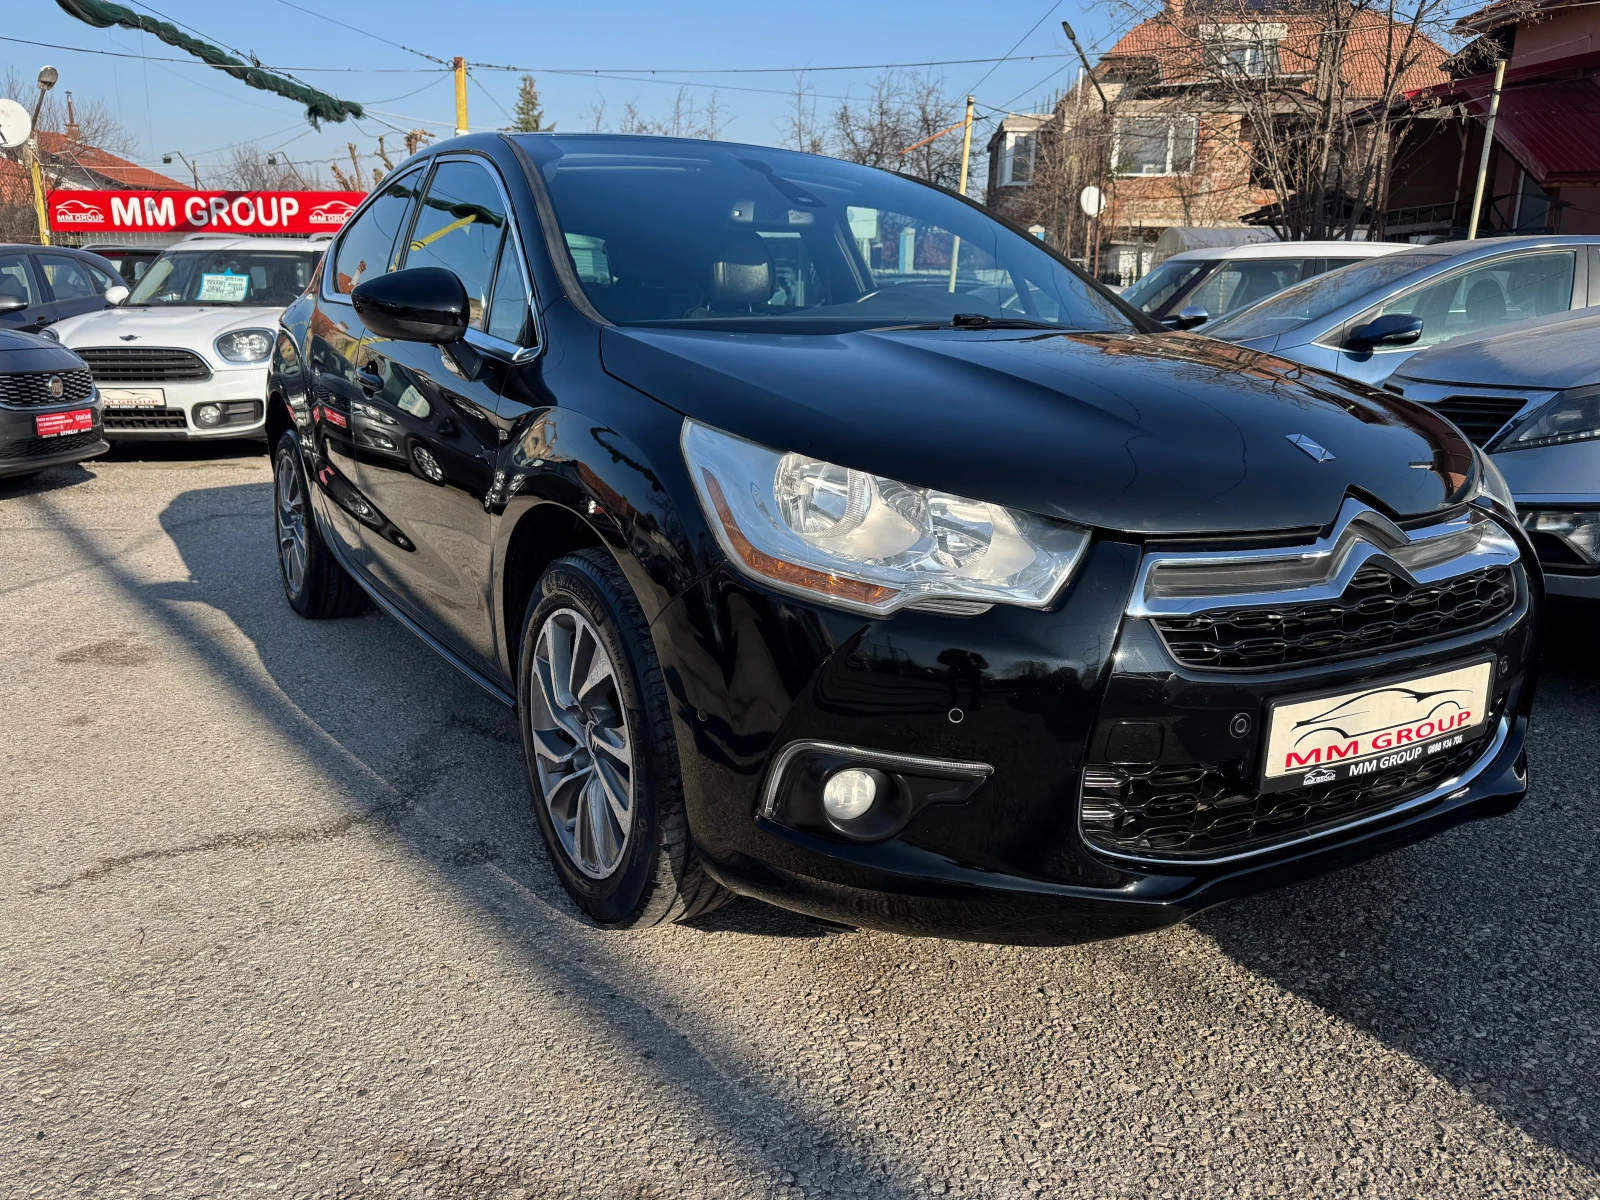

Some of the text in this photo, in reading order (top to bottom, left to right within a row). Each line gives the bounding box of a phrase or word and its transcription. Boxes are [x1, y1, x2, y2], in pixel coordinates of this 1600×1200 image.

[110, 196, 299, 227] MM GROUP
[606, 631, 631, 689] PRIMACY
[1285, 711, 1471, 768] MM GROUP
[1349, 759, 1377, 777] MM
[1379, 747, 1422, 769] GROUP
[1427, 742, 1442, 754] 0888
[1442, 738, 1453, 749] 936
